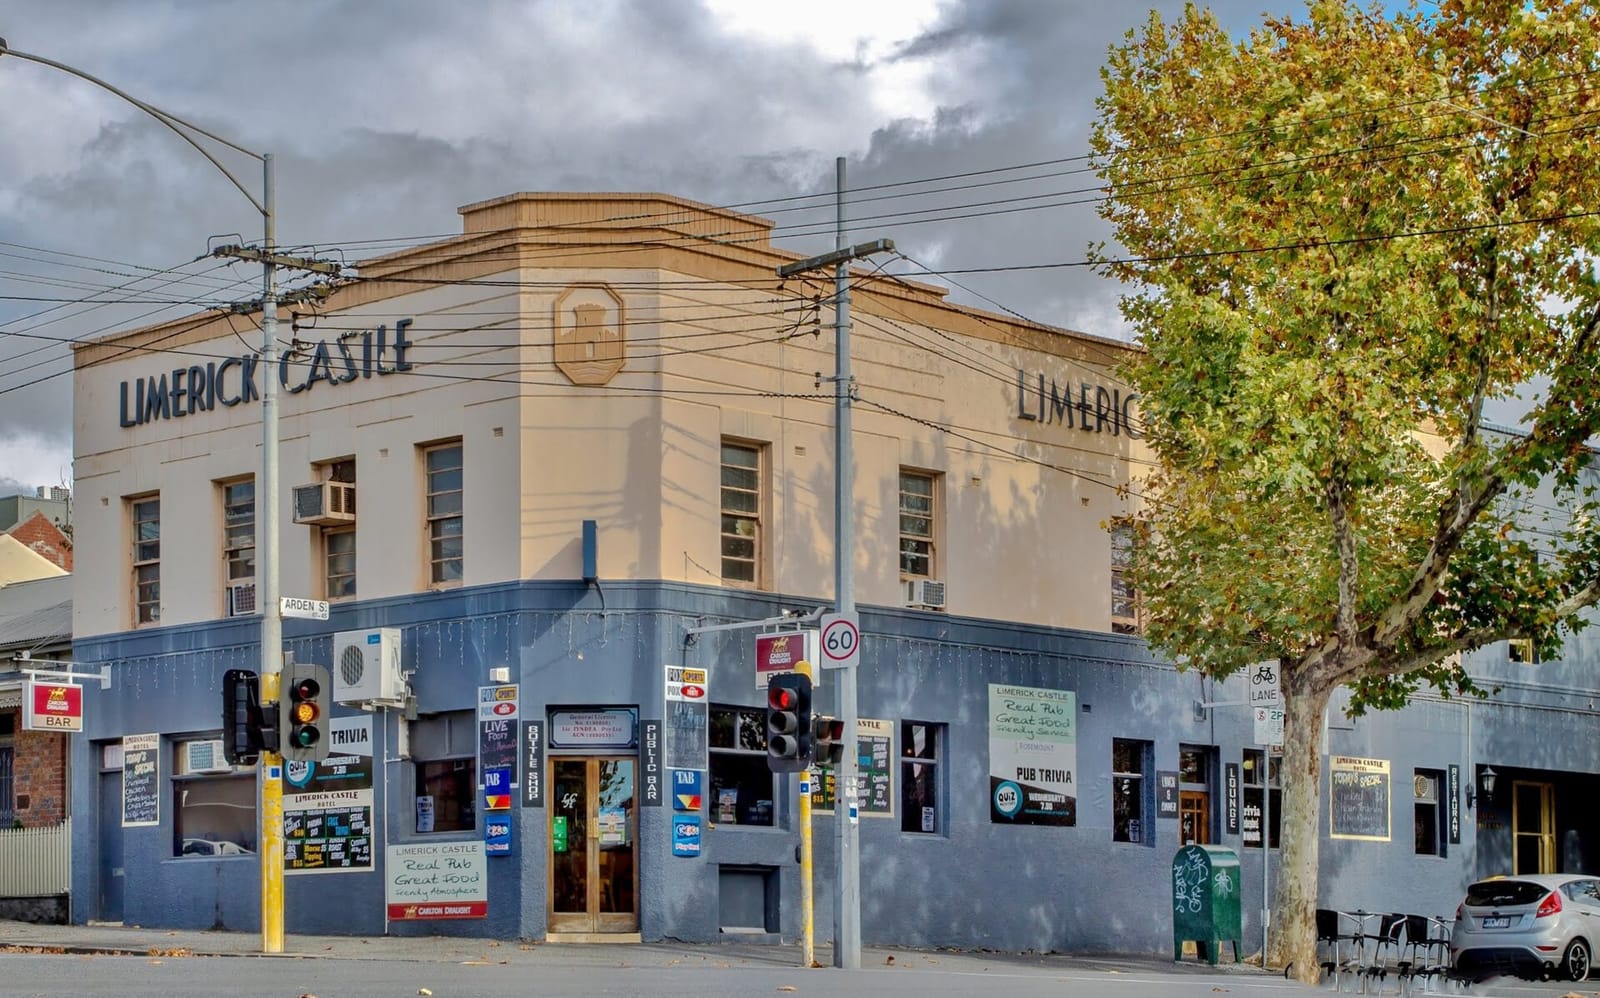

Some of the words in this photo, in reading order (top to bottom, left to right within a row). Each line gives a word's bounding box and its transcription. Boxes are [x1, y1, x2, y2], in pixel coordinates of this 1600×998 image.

[120, 353, 259, 428] LIMERICK
[278, 318, 413, 394] CASTLE
[285, 599, 314, 611] ARDEN
[827, 630, 853, 650] 60
[668, 668, 683, 682] FOX
[996, 687, 1034, 697] LIMERICK
[1037, 691, 1068, 700] CASTLE
[1251, 688, 1277, 701] LANE
[1003, 699, 1036, 713] Real
[1040, 702, 1064, 715] Pub
[46, 717, 71, 727] BAR
[995, 712, 1036, 726] Great
[1038, 717, 1070, 728] Food
[1270, 710, 1283, 721] 2P
[485, 720, 508, 733] LIVE
[331, 728, 368, 745] TRIVIA
[528, 725, 539, 769] BOTTLE
[646, 724, 657, 772] PUBLIC
[485, 772, 500, 786] TAB
[676, 771, 695, 784] TAB
[1016, 767, 1036, 781] PUB
[1039, 768, 1073, 784] TRIVIA
[528, 772, 538, 800] SHOP
[647, 776, 657, 800] BAR
[295, 793, 330, 803] LIMERICK
[330, 791, 358, 800] CASTLE
[1229, 767, 1237, 828] LOUNGE
[396, 847, 439, 856] LIMERICK
[441, 845, 479, 853] CASTLE
[403, 859, 441, 871] Real
[444, 857, 472, 869] Pub
[394, 873, 440, 885] Great
[442, 871, 480, 883] Food
